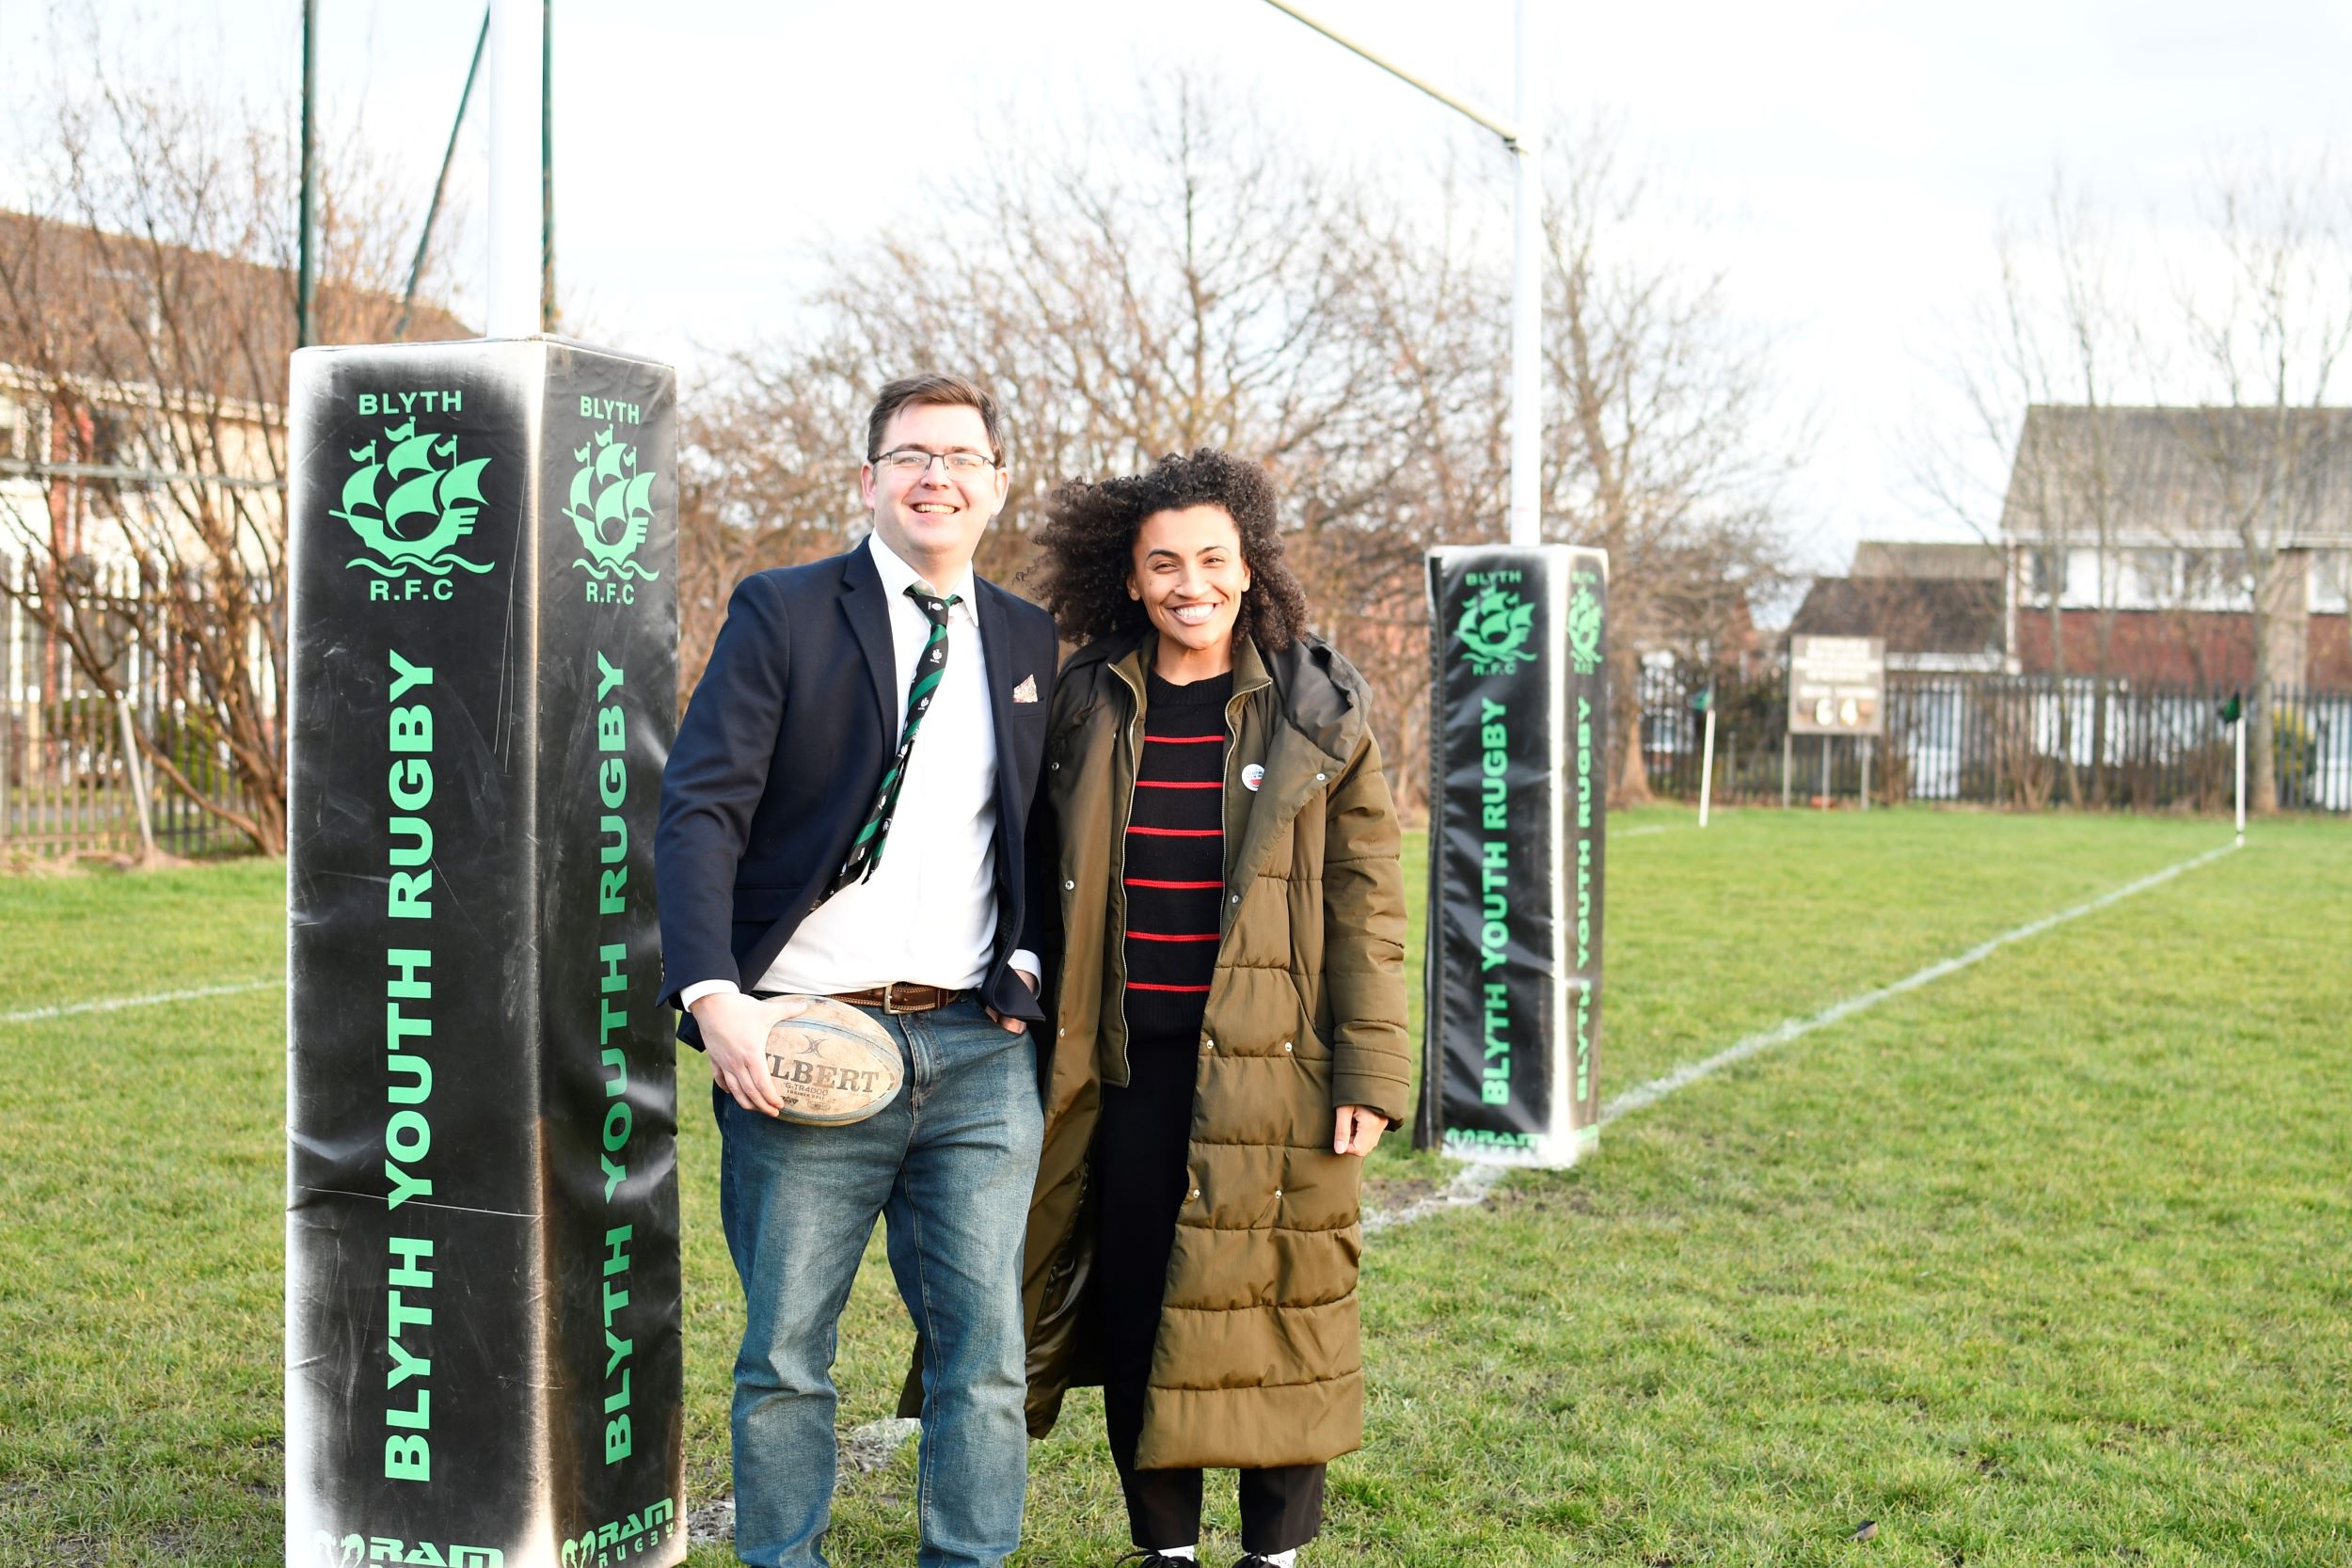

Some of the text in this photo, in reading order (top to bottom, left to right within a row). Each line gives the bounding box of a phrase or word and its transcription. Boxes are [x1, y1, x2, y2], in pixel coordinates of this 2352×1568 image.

[358, 390, 463, 416] BLYTH
[580, 395, 641, 425] BLYTH
[370, 578, 454, 602] R.F.C
[585, 580, 635, 605] R.F.C
[1465, 570, 1522, 586] BLYTH
[1481, 697, 1511, 1105] BLYTH YOUTH RUGBY
[385, 649, 434, 1482] BLYTH YOUTH RUGBY
[597, 649, 633, 1465] BLYTH YOUTH RUGBY
[598, 1497, 674, 1550] RAM
[371, 1536, 504, 1568] RAM
